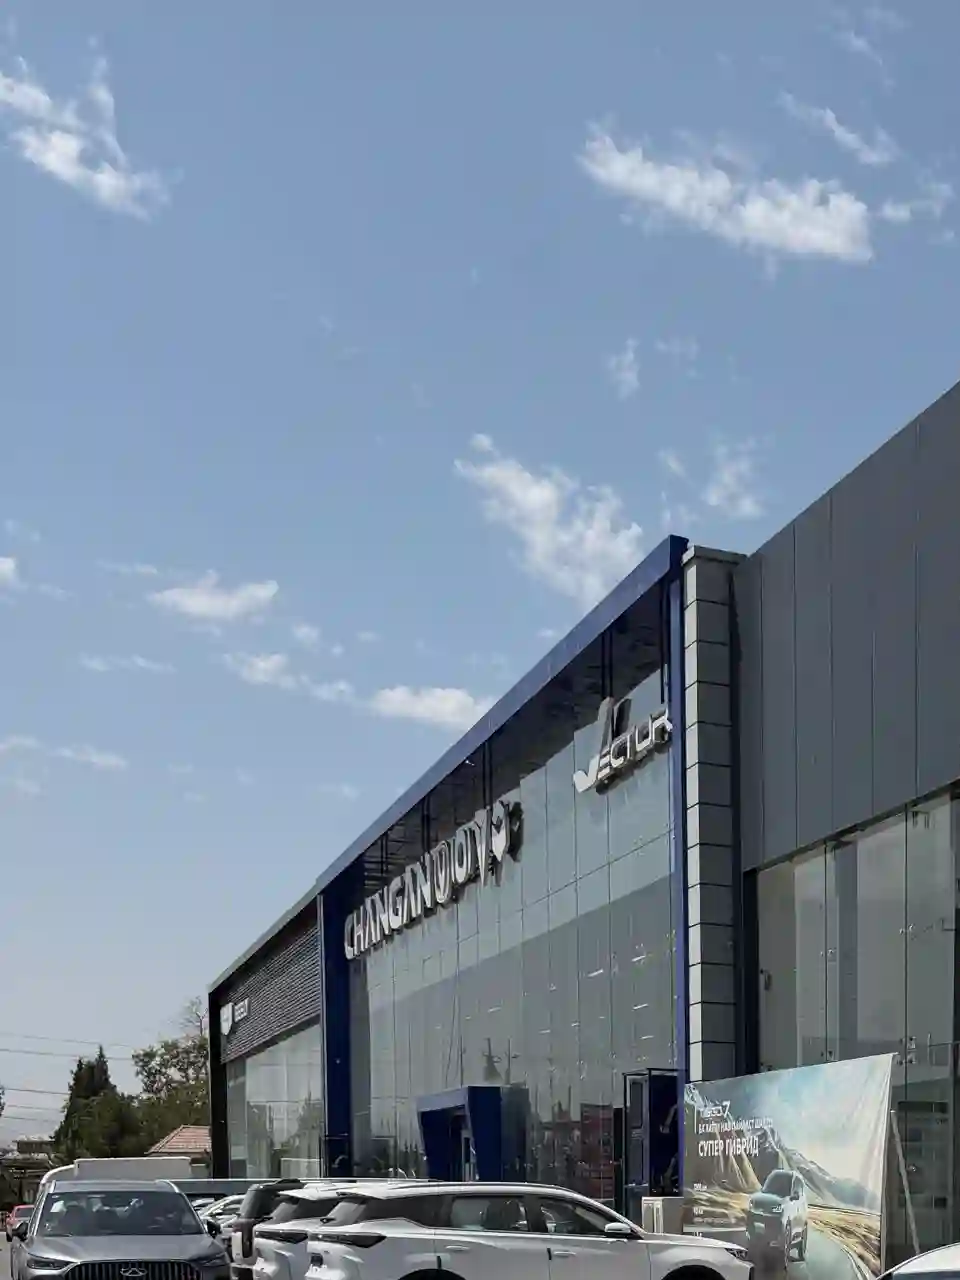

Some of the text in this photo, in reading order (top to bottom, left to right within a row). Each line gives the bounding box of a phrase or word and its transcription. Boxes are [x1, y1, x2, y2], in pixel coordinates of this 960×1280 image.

[344, 852, 433, 960] CHANGAN
[698, 1136, 759, 1157] СУПЕР ГИБРИД
